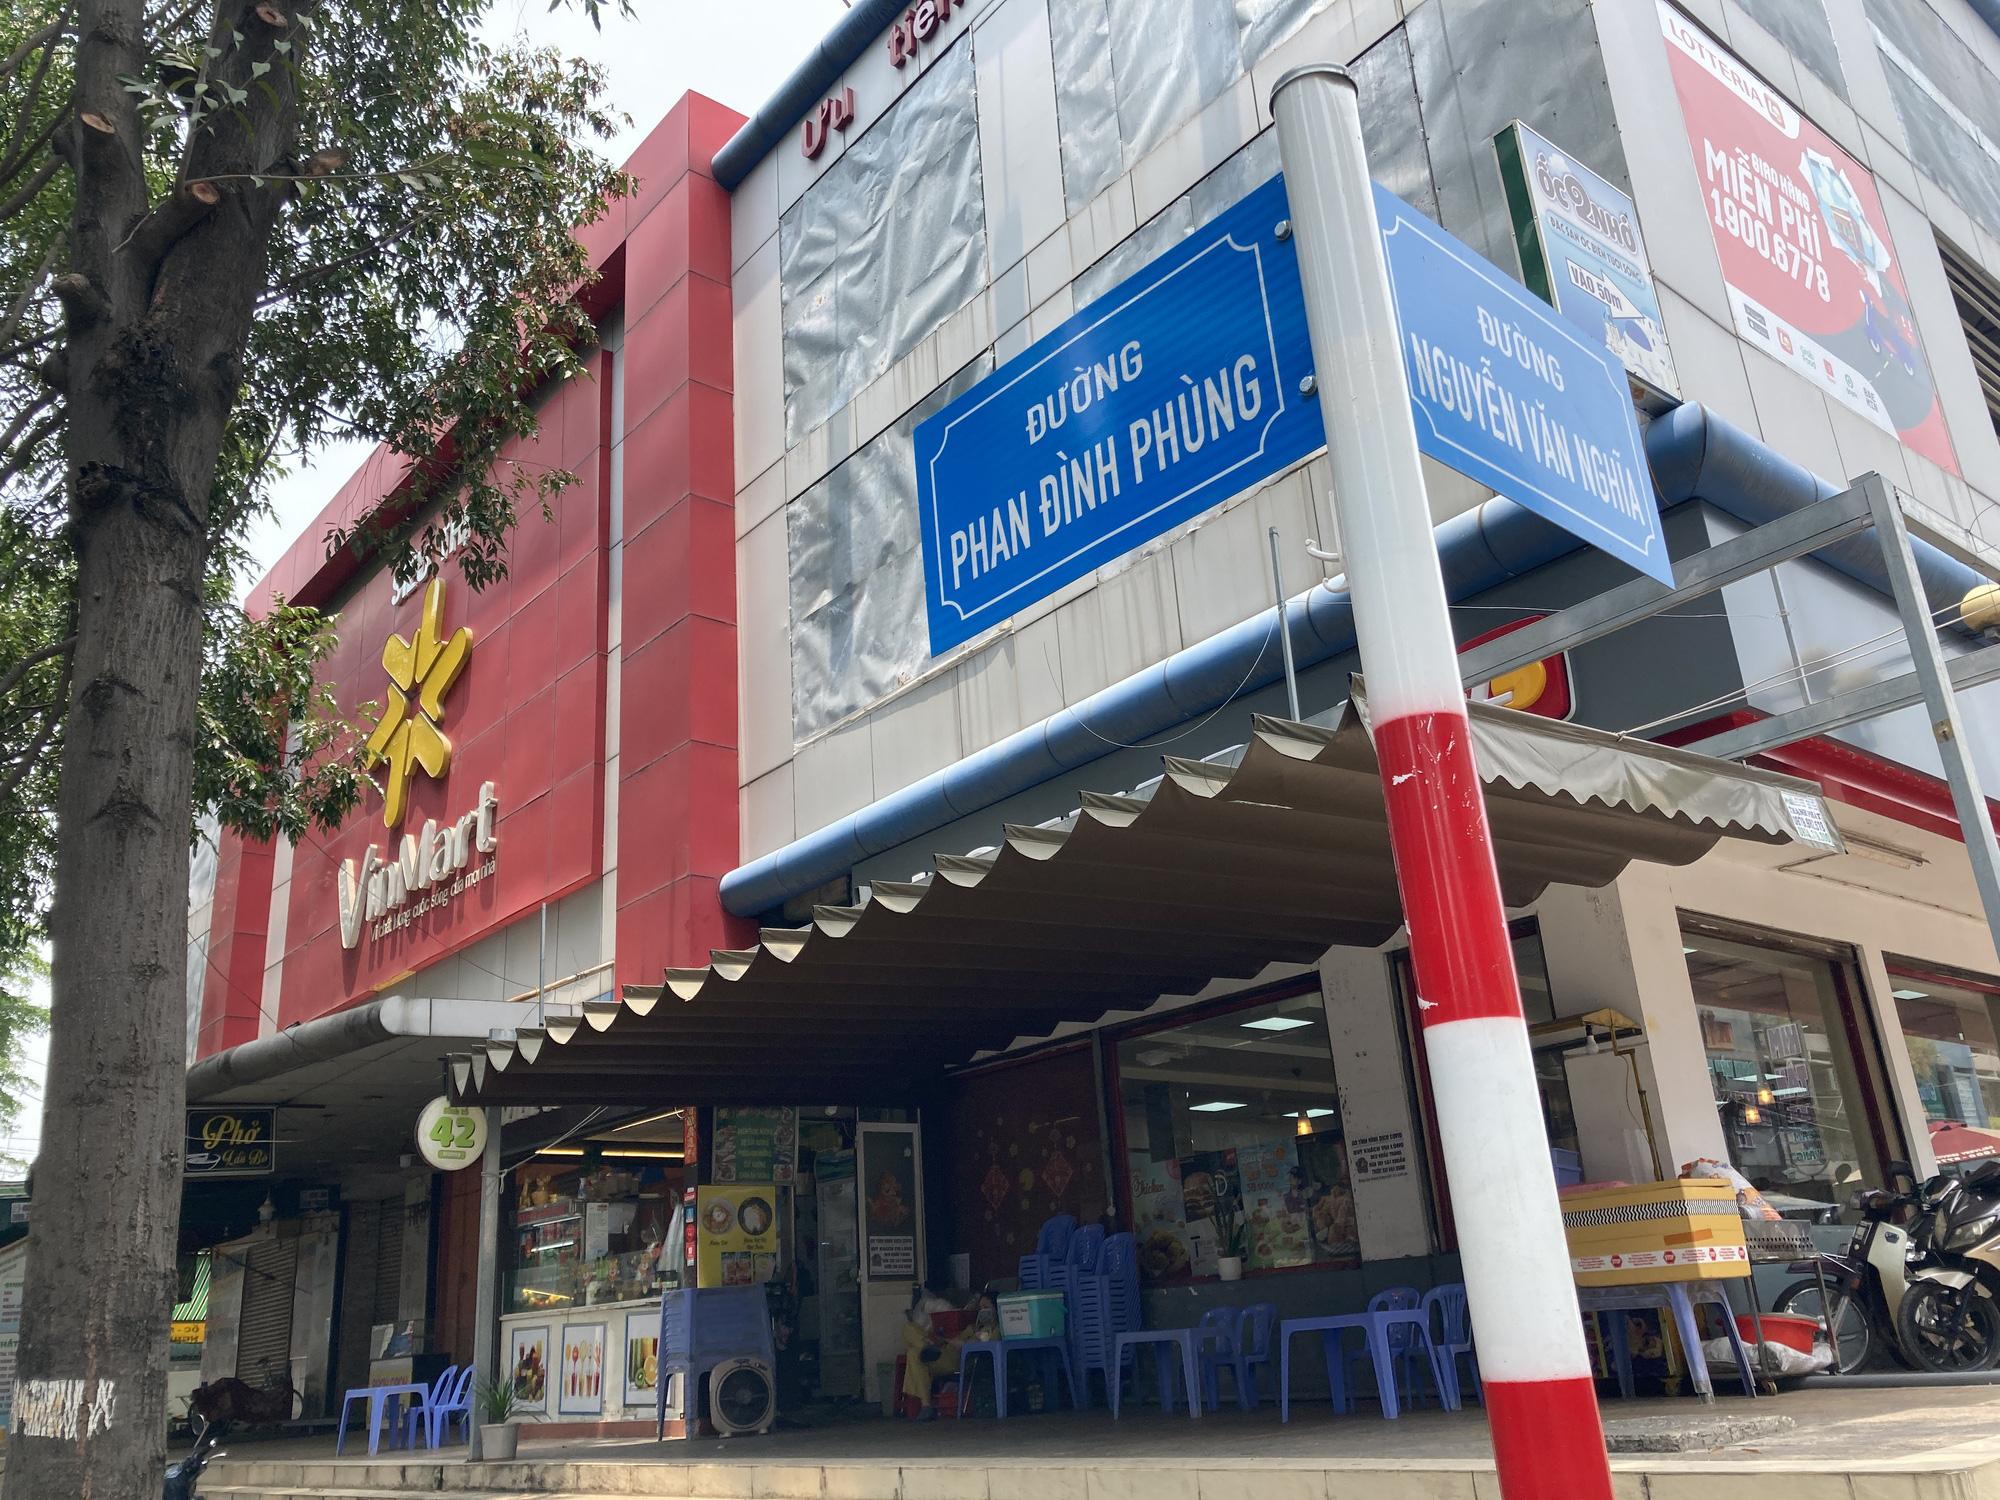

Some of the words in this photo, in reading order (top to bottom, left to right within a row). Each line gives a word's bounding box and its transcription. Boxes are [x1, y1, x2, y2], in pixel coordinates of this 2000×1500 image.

[1669, 18, 1765, 108] LOTTERIA
[1704, 137, 1774, 226] MIỄN
[1778, 194, 1823, 262] PHÍ
[1751, 152, 1779, 188] GIAO
[1780, 174, 1810, 212] HÀNG
[1570, 265, 1596, 294] VÀO
[1597, 281, 1623, 311] 50m
[1711, 188, 1830, 303] 1900.6778
[1026, 340, 1144, 445] ĐƯỜNG
[1476, 305, 1564, 392] ĐƯỜNG
[950, 491, 1031, 589] PHAN
[1039, 437, 1120, 537] ĐÌNH
[1129, 353, 1262, 484] PHÙNG
[1410, 332, 1523, 452] NGUYỄN
[1521, 399, 1576, 483] VĂN
[1573, 432, 1646, 526] NGHĨA
[338, 781, 498, 948] VinMart
[431, 886, 449, 907] sống
[480, 856, 496, 880] nhà
[202, 1114, 262, 1150] Phở
[429, 1116, 475, 1148] 42
